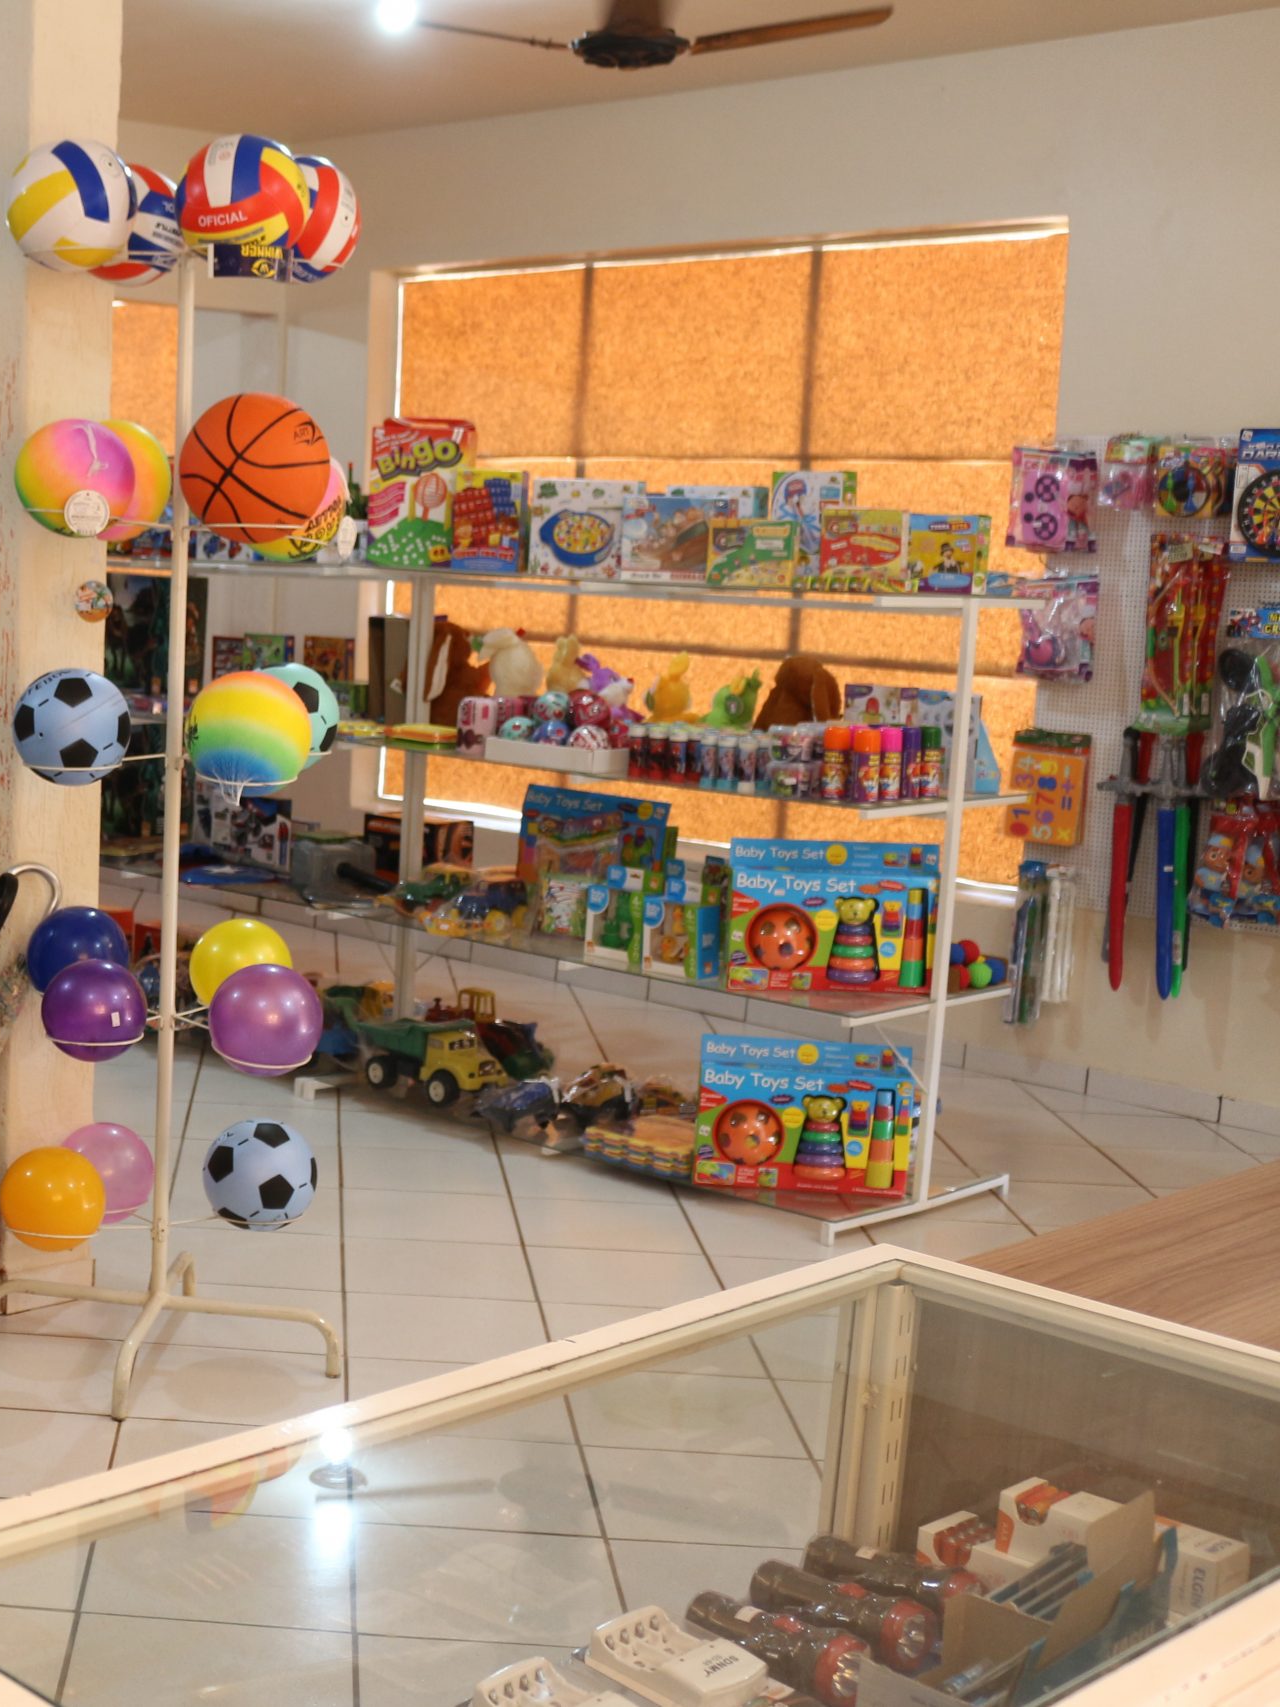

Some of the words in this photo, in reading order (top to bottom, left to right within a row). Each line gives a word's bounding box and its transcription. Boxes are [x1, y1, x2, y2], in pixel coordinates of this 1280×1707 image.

[198, 210, 248, 227] OFICIAL
[241, 244, 283, 259] WINNER
[376, 436, 460, 476] Bingo
[735, 846, 766, 861] Baby
[770, 847, 799, 861] Toys
[801, 848, 825, 860] Set
[736, 872, 777, 893] Baby
[782, 875, 822, 895] Toys
[826, 878, 857, 894] Set
[706, 1041, 737, 1057] Baby
[740, 1044, 769, 1059] Toys
[772, 1047, 796, 1058] Set
[704, 1068, 745, 1089] Baby
[750, 1072, 789, 1092] Toys
[794, 1076, 825, 1091] Set
